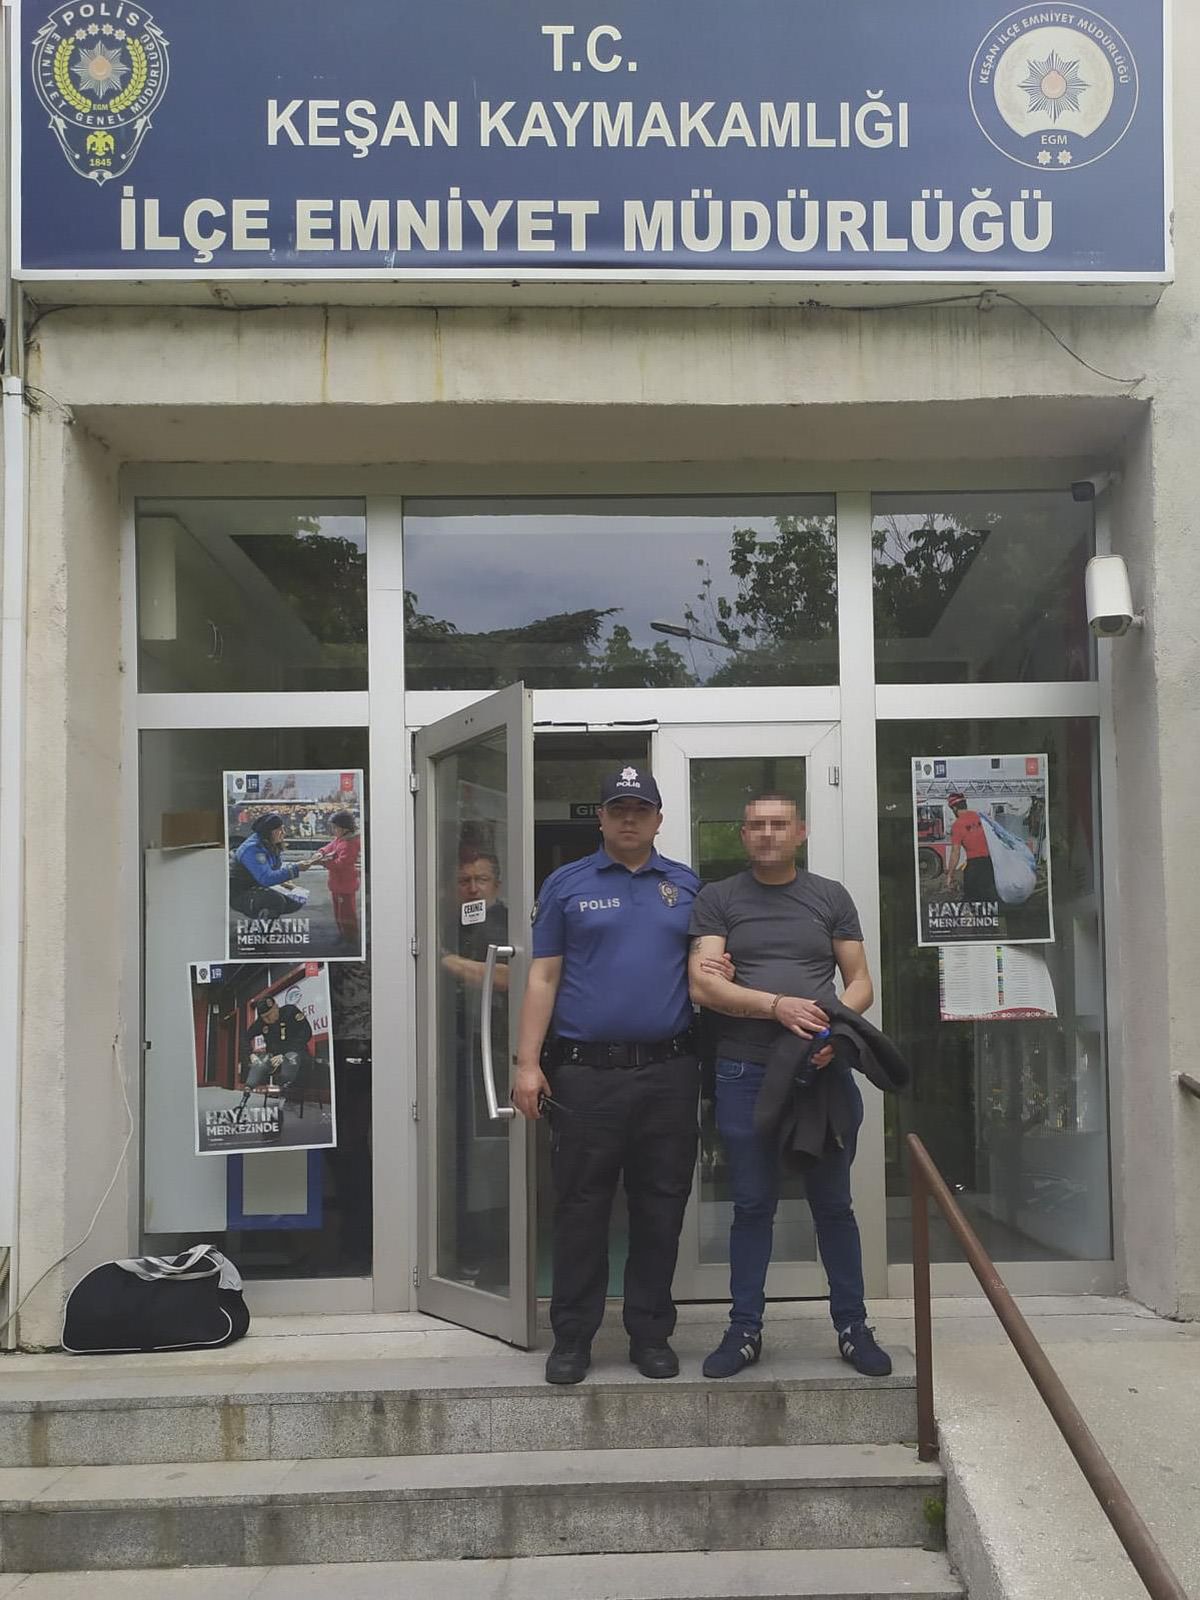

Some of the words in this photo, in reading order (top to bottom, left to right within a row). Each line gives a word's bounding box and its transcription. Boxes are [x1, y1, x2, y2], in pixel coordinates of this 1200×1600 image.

[62, 3, 140, 26] POLİS
[540, 25, 638, 73] T.C.
[75, 113, 125, 125] GENEL
[267, 100, 458, 158] KEŞAN
[480, 90, 909, 149] KAYMAKAMLIĞI
[1041, 135, 1068, 145] EGM
[90, 158, 112, 167] 1845
[120, 186, 271, 263] İLÇE
[296, 187, 600, 252] EMNİYET
[623, 188, 1053, 253] MÜDÜRLÜĞÜ
[579, 898, 621, 912] POLİS
[928, 901, 999, 917] HAYATIN
[237, 918, 310, 933] HAYATIN
[237, 934, 310, 945] MERKEZİNDE
[206, 1106, 279, 1125] HAYATIN
[206, 1122, 280, 1136] MERKEZİNDE
